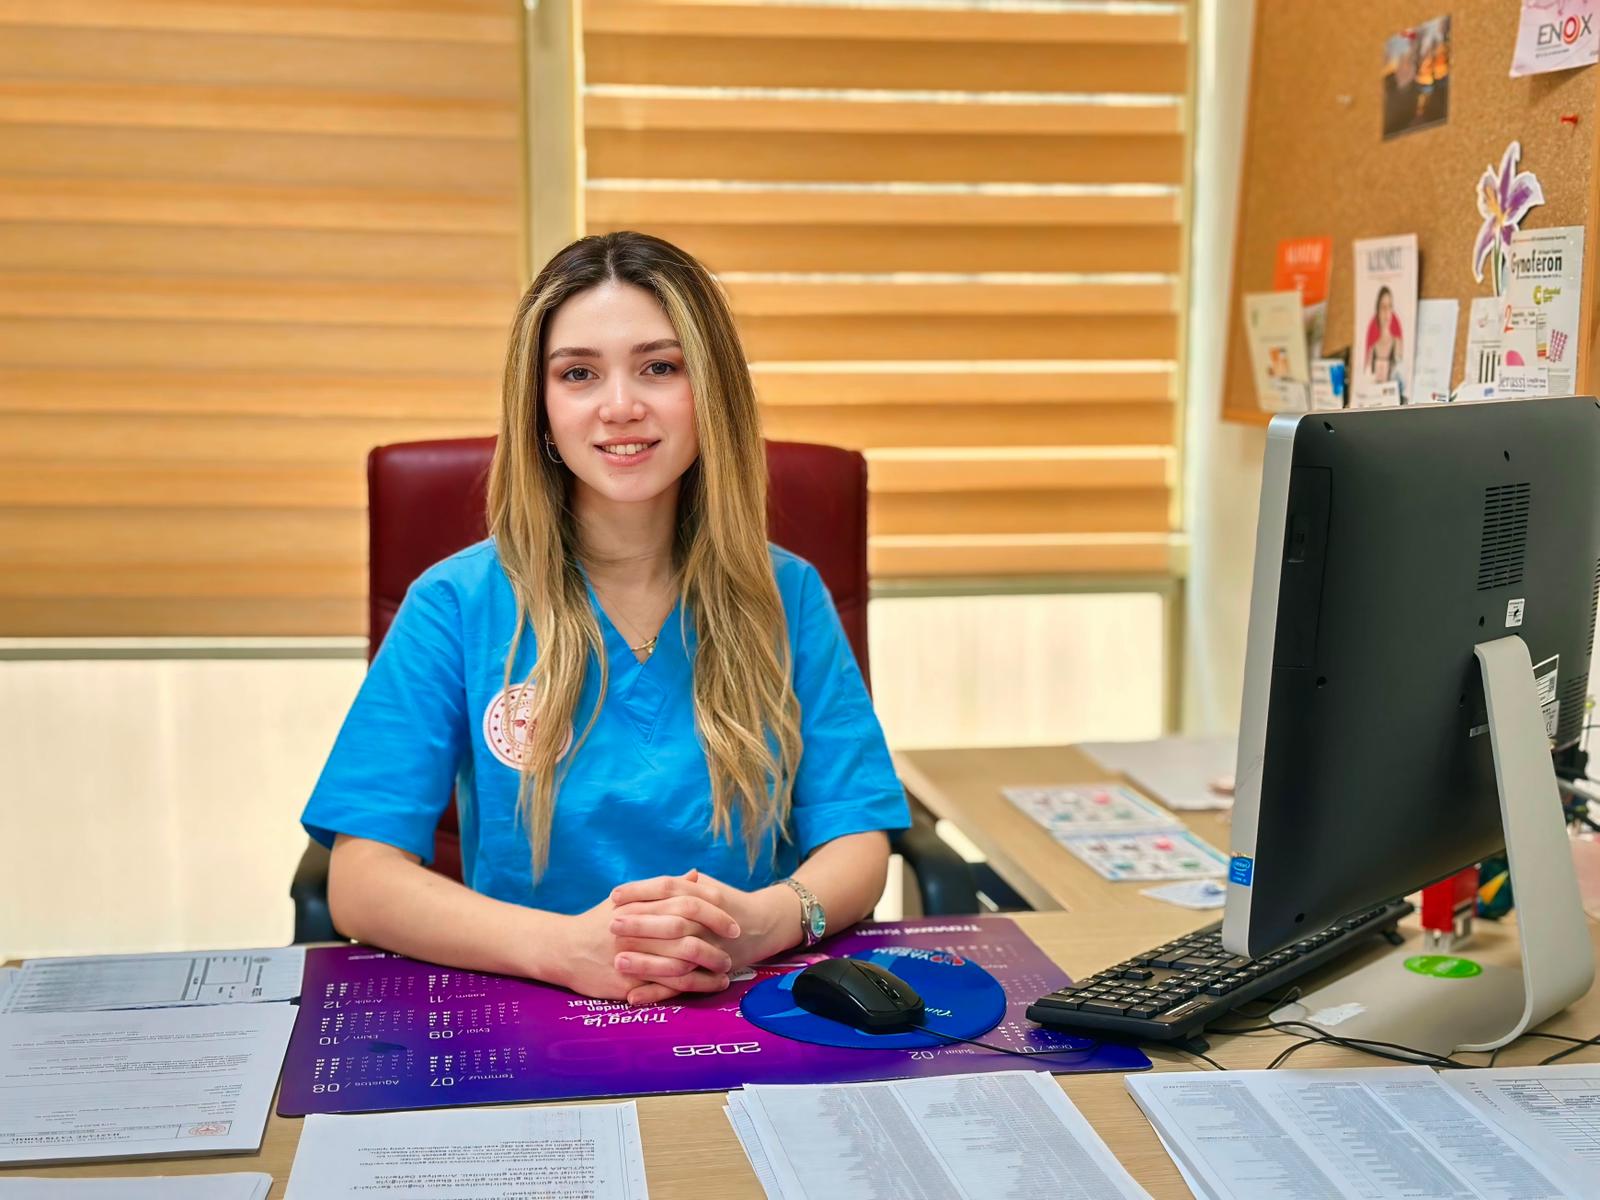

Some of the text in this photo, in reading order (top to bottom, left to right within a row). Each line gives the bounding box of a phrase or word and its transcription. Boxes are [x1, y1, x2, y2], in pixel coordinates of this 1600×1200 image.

[1537, 13, 1592, 46] ENOX
[323, 1001, 341, 1009] 12
[429, 1030, 453, 1039] 09
[319, 1036, 340, 1046] 10
[672, 1041, 761, 1057] 2026
[907, 1051, 934, 1060] 02
[429, 1077, 454, 1087] 07
[312, 1083, 340, 1093] 08
